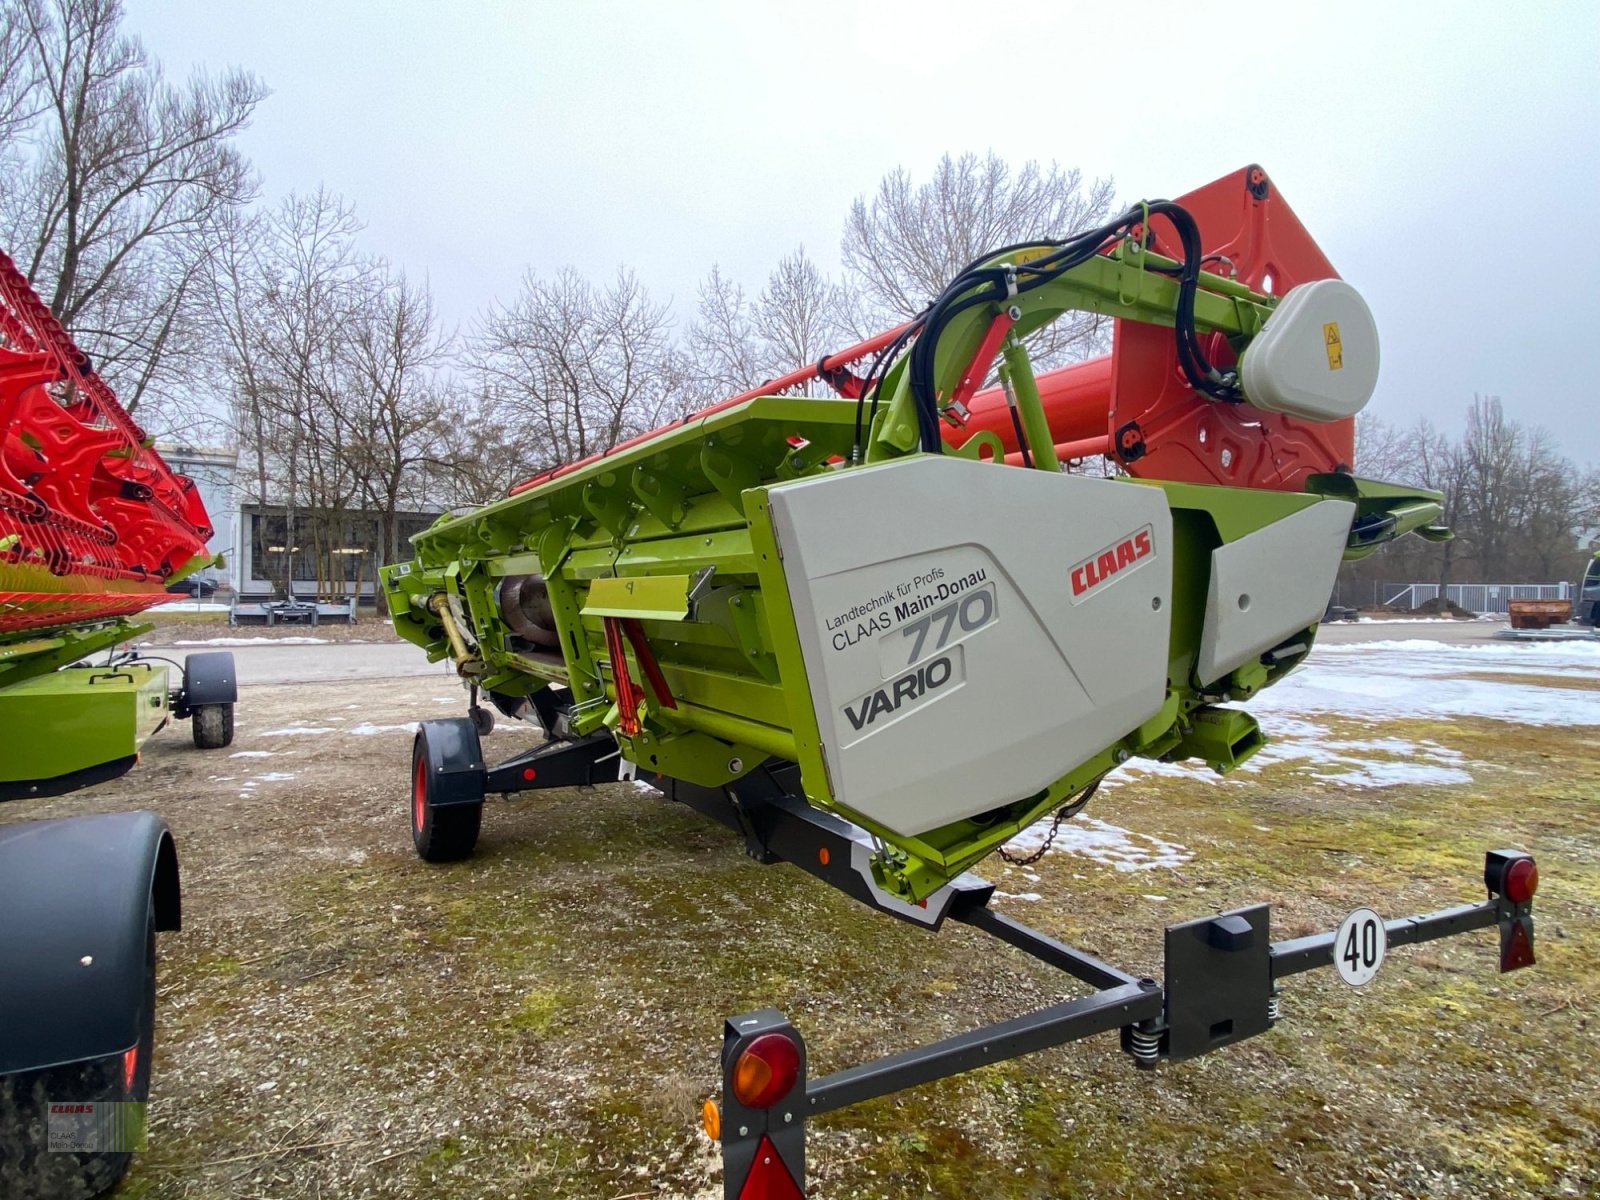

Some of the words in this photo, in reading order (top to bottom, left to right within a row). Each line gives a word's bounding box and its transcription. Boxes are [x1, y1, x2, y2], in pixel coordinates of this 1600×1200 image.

[825, 589, 896, 631] Landtechnik
[896, 583, 912, 598] für
[913, 567, 945, 590] Profis
[1071, 530, 1151, 597] CLAAS
[832, 611, 892, 651] CLAAS
[894, 568, 987, 622] Main-Donau
[903, 590, 993, 665] 770
[844, 656, 952, 731] VARIO
[1343, 918, 1377, 972] 40
